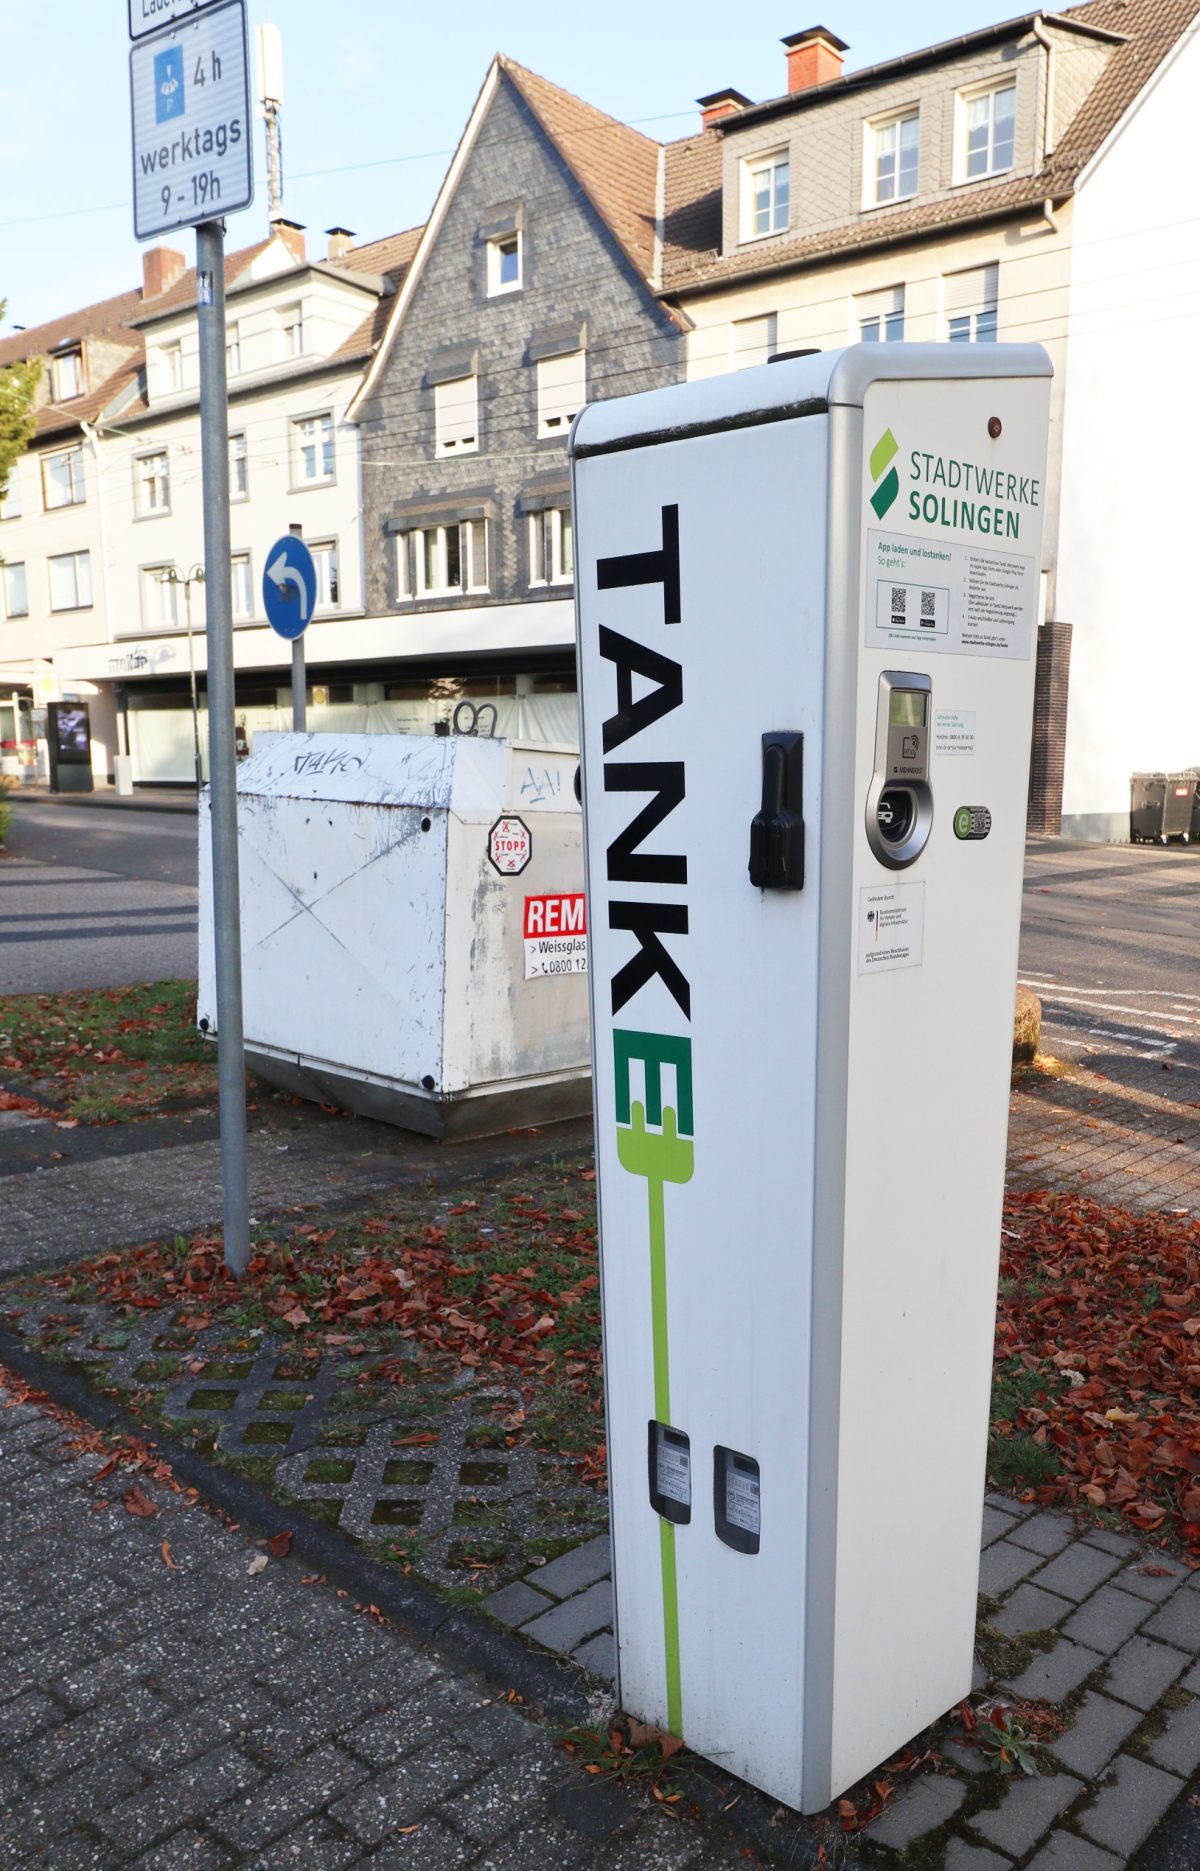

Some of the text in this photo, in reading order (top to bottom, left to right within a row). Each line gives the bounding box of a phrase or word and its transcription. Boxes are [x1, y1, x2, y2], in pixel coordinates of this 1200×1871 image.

[193, 50, 221, 86] 4 h
[140, 119, 241, 174] werktags
[161, 185, 171, 215] 9
[191, 170, 221, 206] 19h
[910, 451, 1040, 506] STADTWERKE
[909, 490, 1020, 539] SOLINGEN
[878, 542, 891, 553] App
[892, 544, 909, 555] laden
[909, 548, 922, 557] und
[878, 556, 886, 565] So
[595, 503, 693, 1136] TANKE
[495, 840, 526, 851] STOPP
[538, 940, 586, 956] Weissglas
[549, 958, 572, 974] 0800
